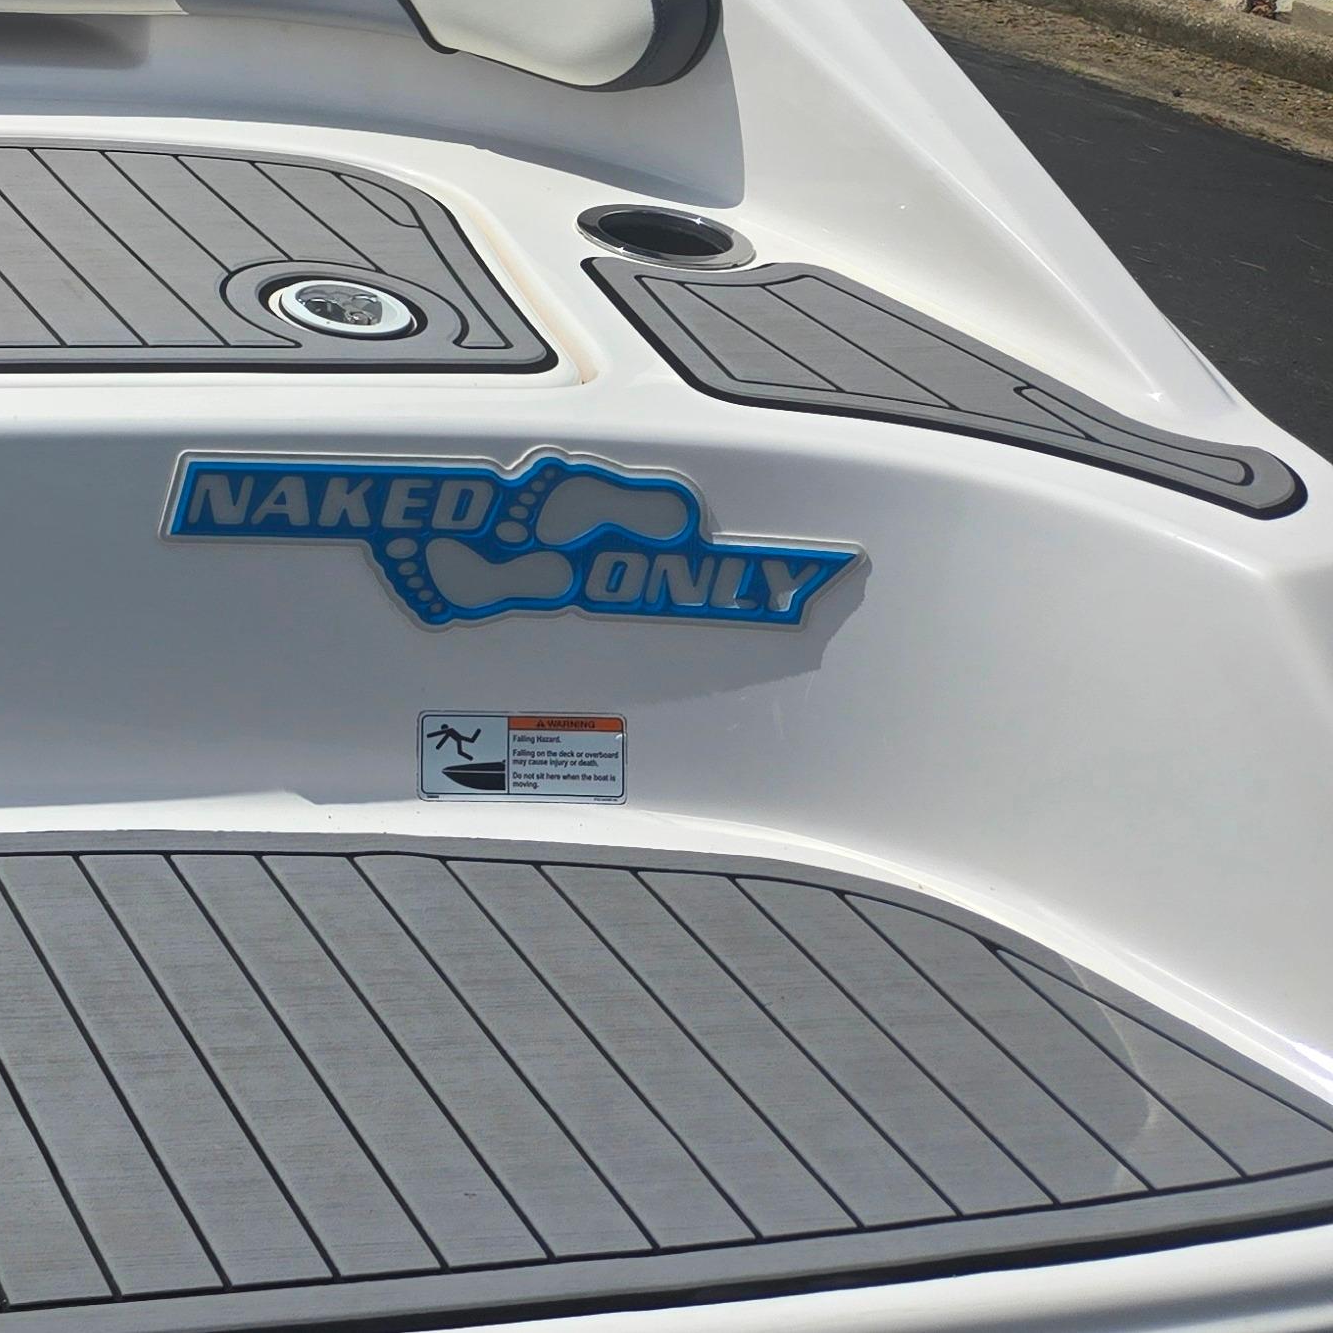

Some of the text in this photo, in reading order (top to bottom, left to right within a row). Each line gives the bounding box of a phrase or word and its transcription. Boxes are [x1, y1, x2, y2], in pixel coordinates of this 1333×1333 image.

[191, 474, 495, 529] NAKED
[584, 551, 821, 613] ONLY
[548, 720, 595, 728] WARNING
[513, 735, 535, 744] Falling
[513, 749, 535, 758] Falling
[550, 759, 568, 768] injury
[512, 771, 522, 779] Do
[610, 774, 616, 782] is
